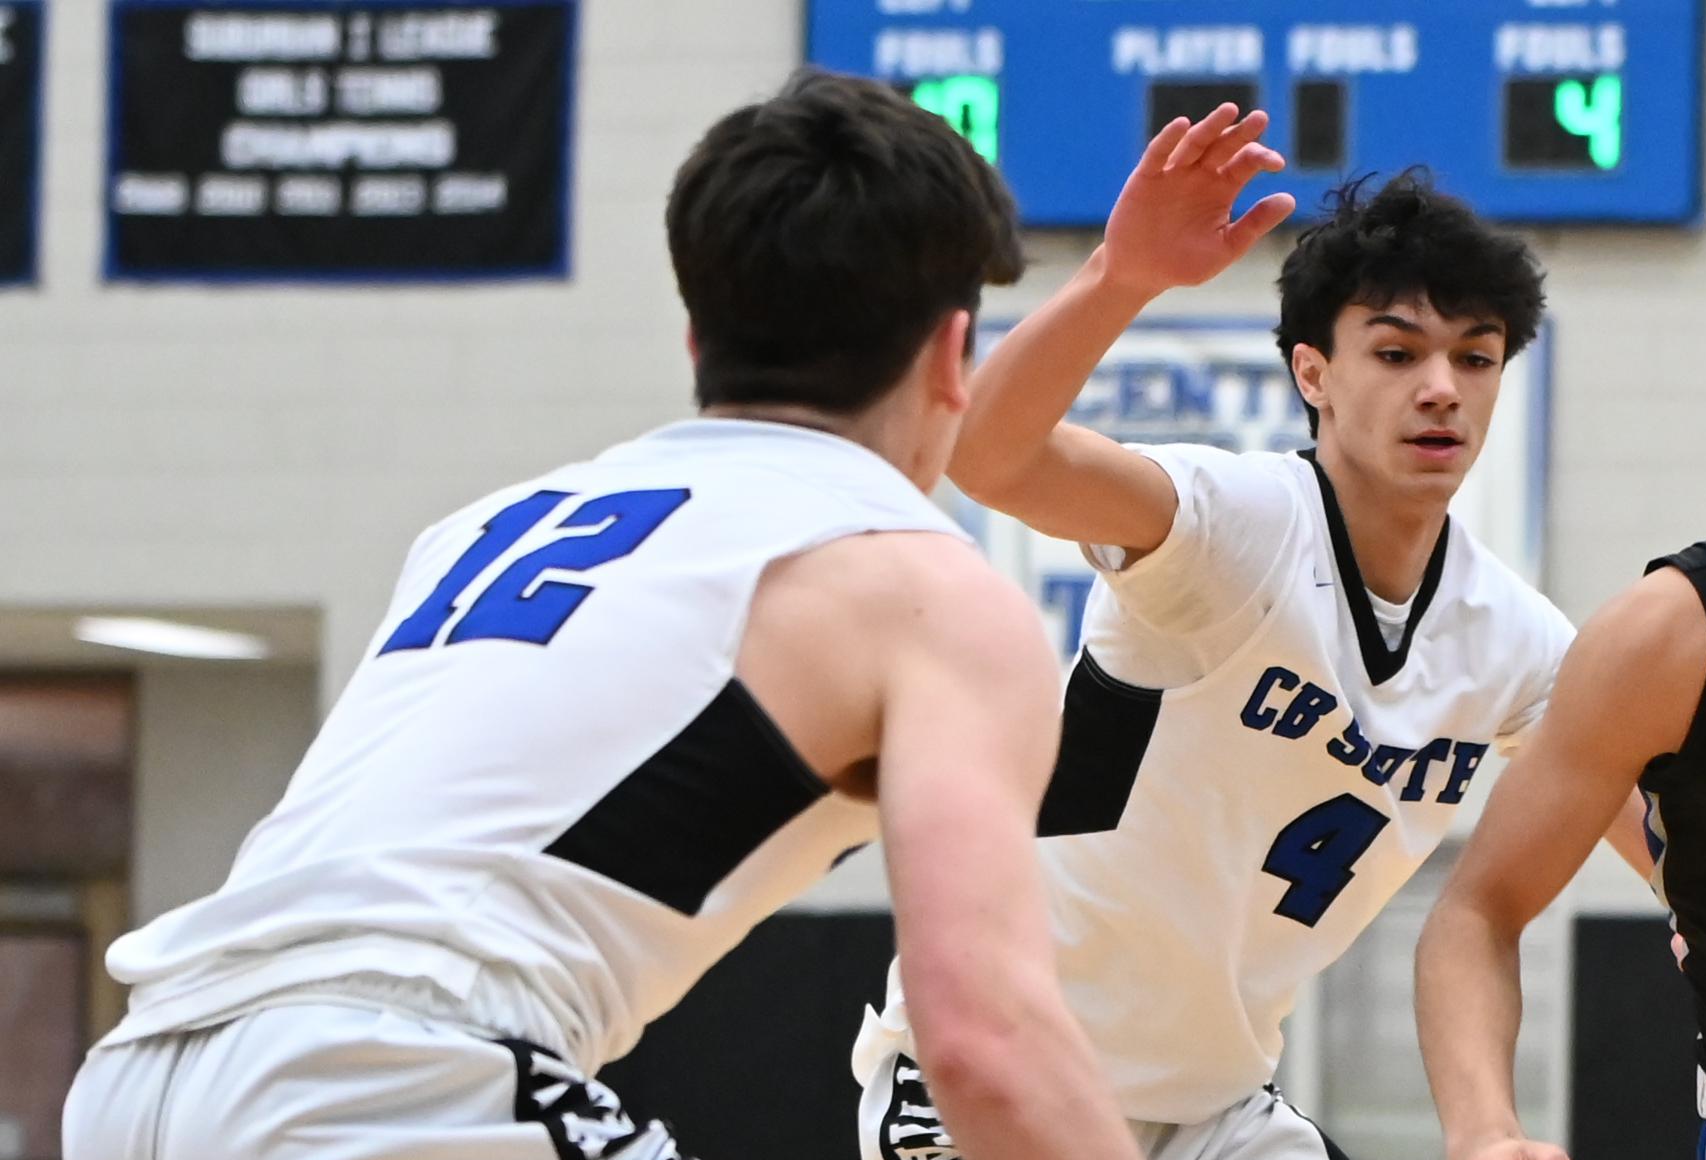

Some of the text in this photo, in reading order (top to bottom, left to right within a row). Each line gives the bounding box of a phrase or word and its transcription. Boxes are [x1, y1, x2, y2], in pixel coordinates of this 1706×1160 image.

[1554, 74, 1621, 169] 4
[377, 487, 691, 657] 12
[1240, 666, 1338, 739] CB
[1260, 792, 1391, 929] 4
